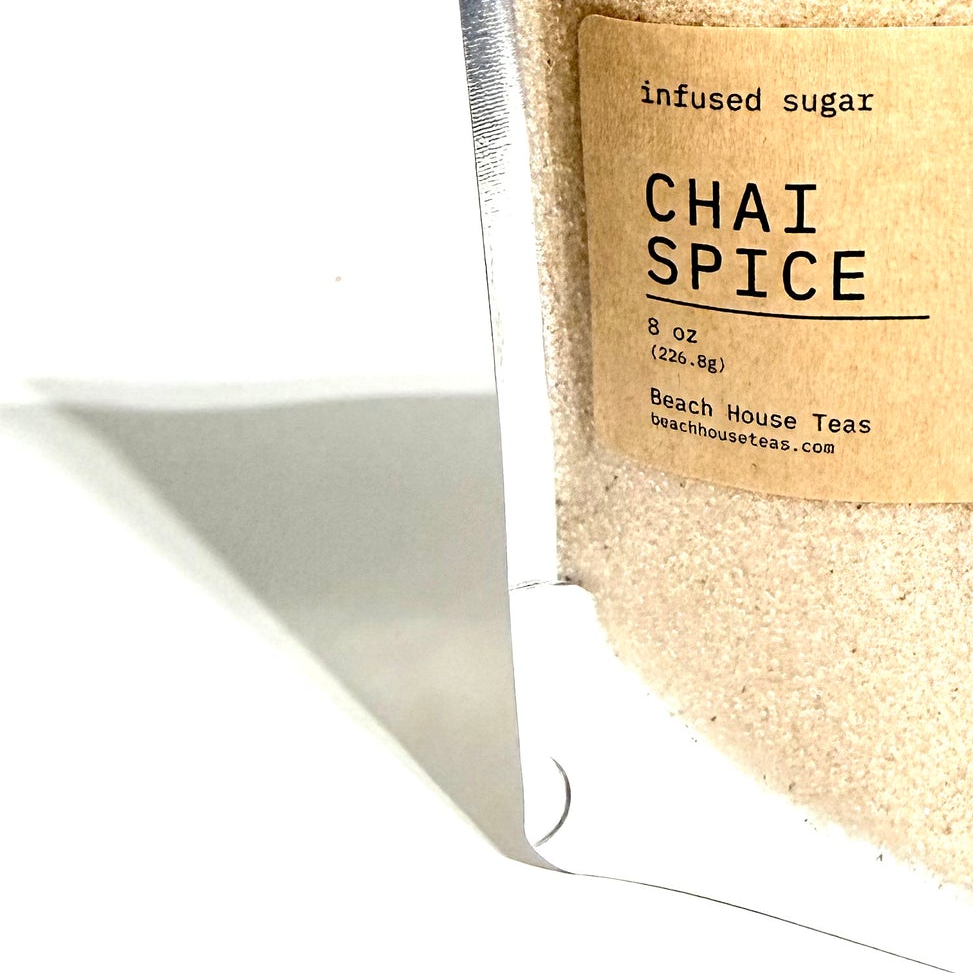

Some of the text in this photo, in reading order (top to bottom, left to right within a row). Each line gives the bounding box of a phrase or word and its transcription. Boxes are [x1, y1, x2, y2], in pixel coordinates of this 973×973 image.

[640, 79, 875, 119] infused sugar
[645, 172, 817, 234] CHAI
[647, 235, 866, 302] SPICE
[647, 316, 698, 344] 8 oz
[651, 344, 725, 375] (226.8g)
[650, 386, 872, 435] Beach House Teas
[650, 411, 835, 455] beachhouseteas.com
